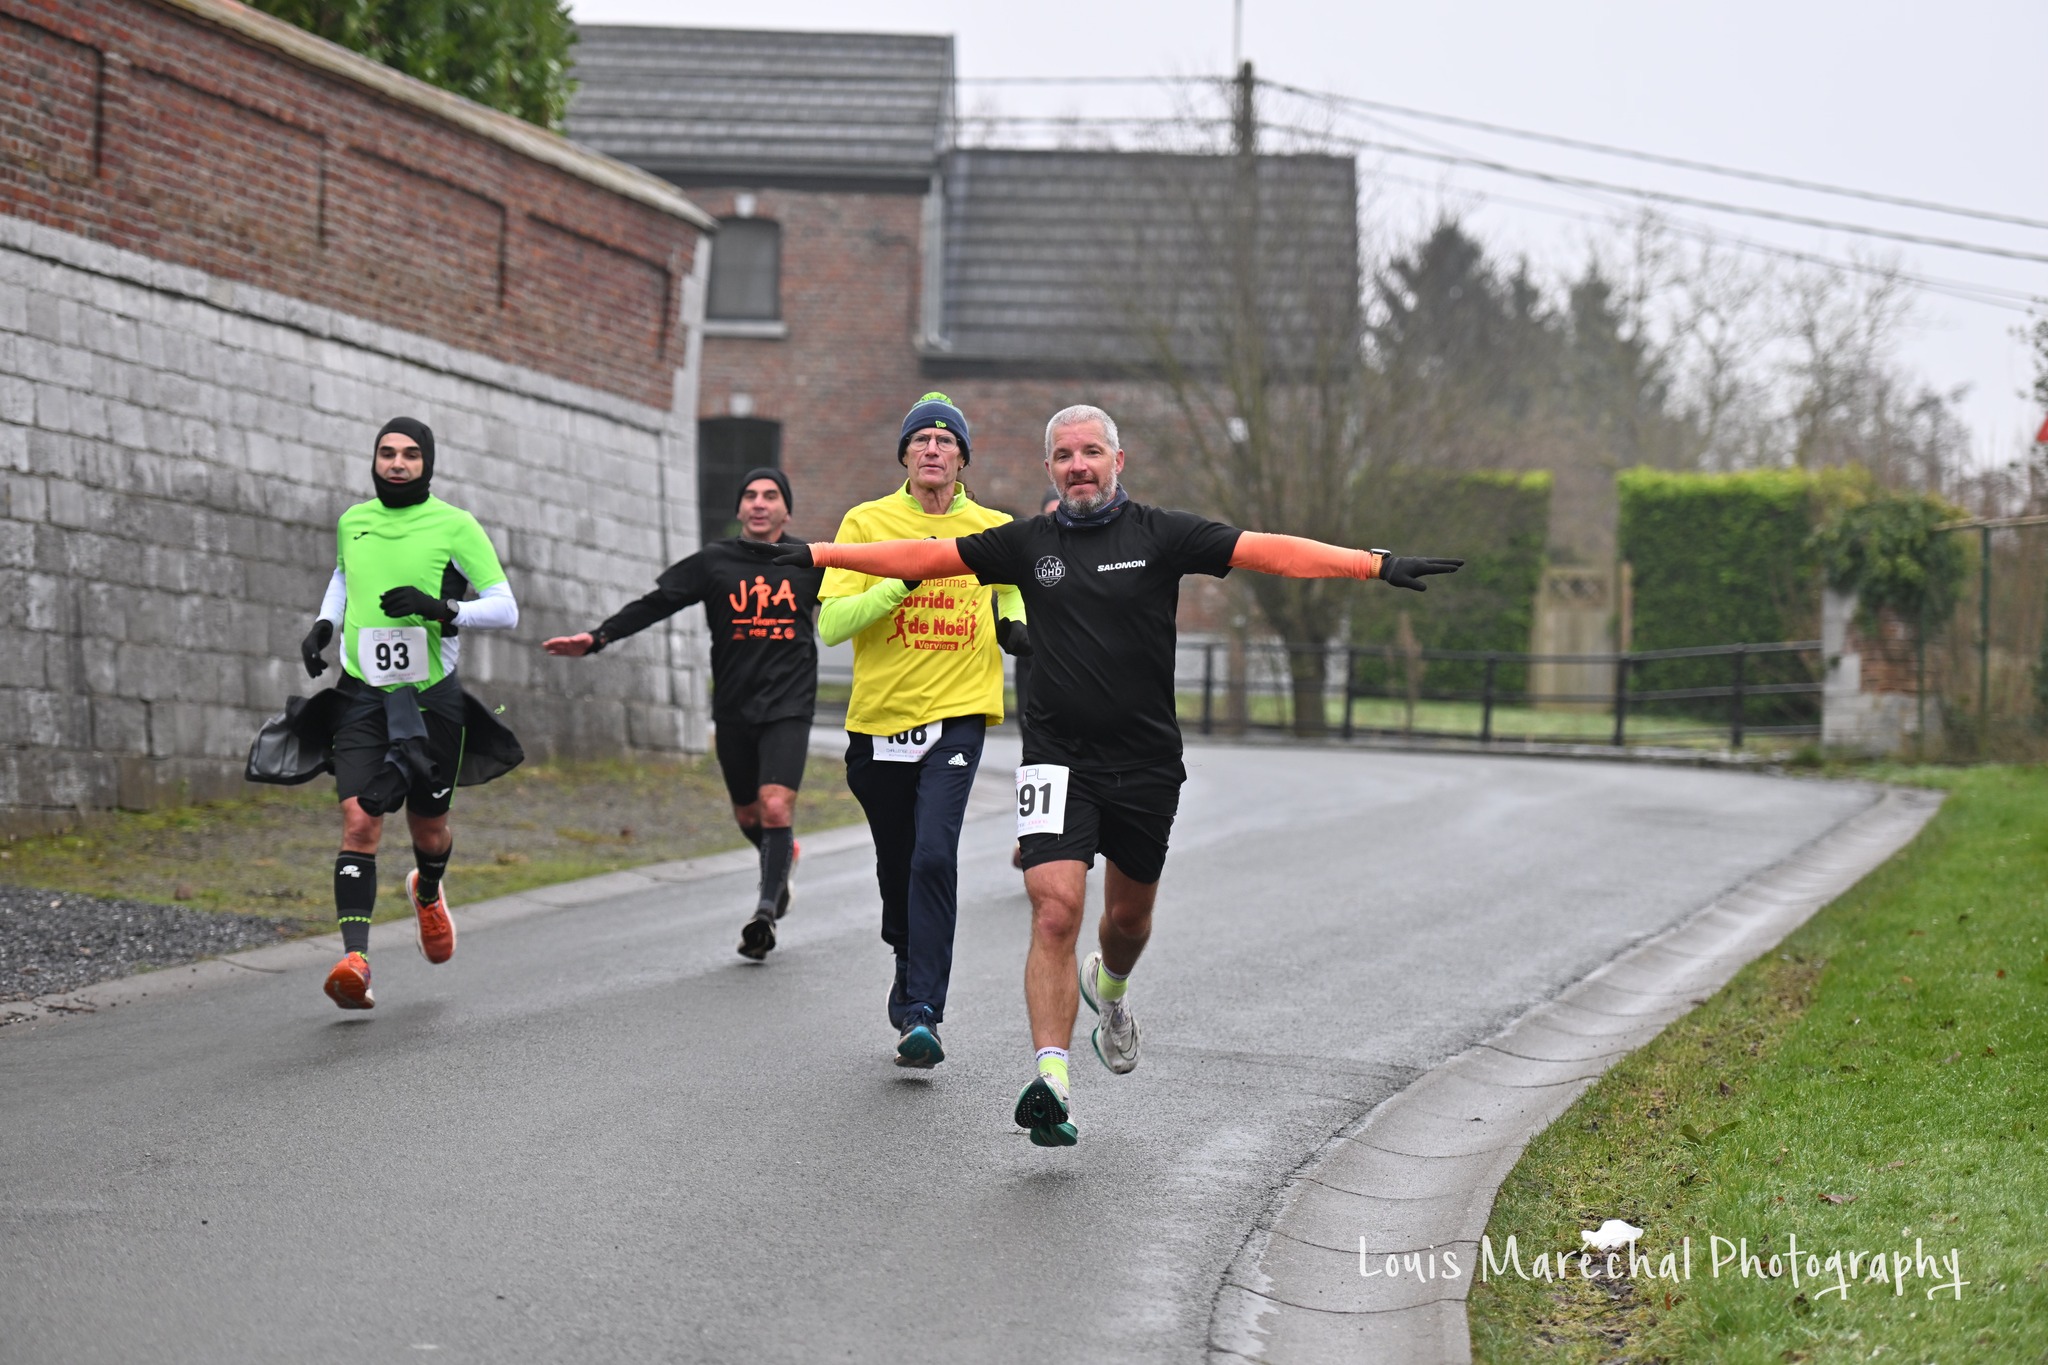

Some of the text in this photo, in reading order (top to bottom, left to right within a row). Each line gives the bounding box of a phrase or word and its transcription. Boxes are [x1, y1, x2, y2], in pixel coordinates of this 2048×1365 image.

[1037, 568, 1062, 578] LDHD
[1097, 560, 1146, 572] SALOMON
[898, 590, 955, 609] orrida
[908, 614, 968, 636] de Noël
[918, 641, 956, 650] Verviers
[375, 643, 409, 671] 93
[887, 724, 928, 746] 08
[1016, 783, 1052, 817] 91
